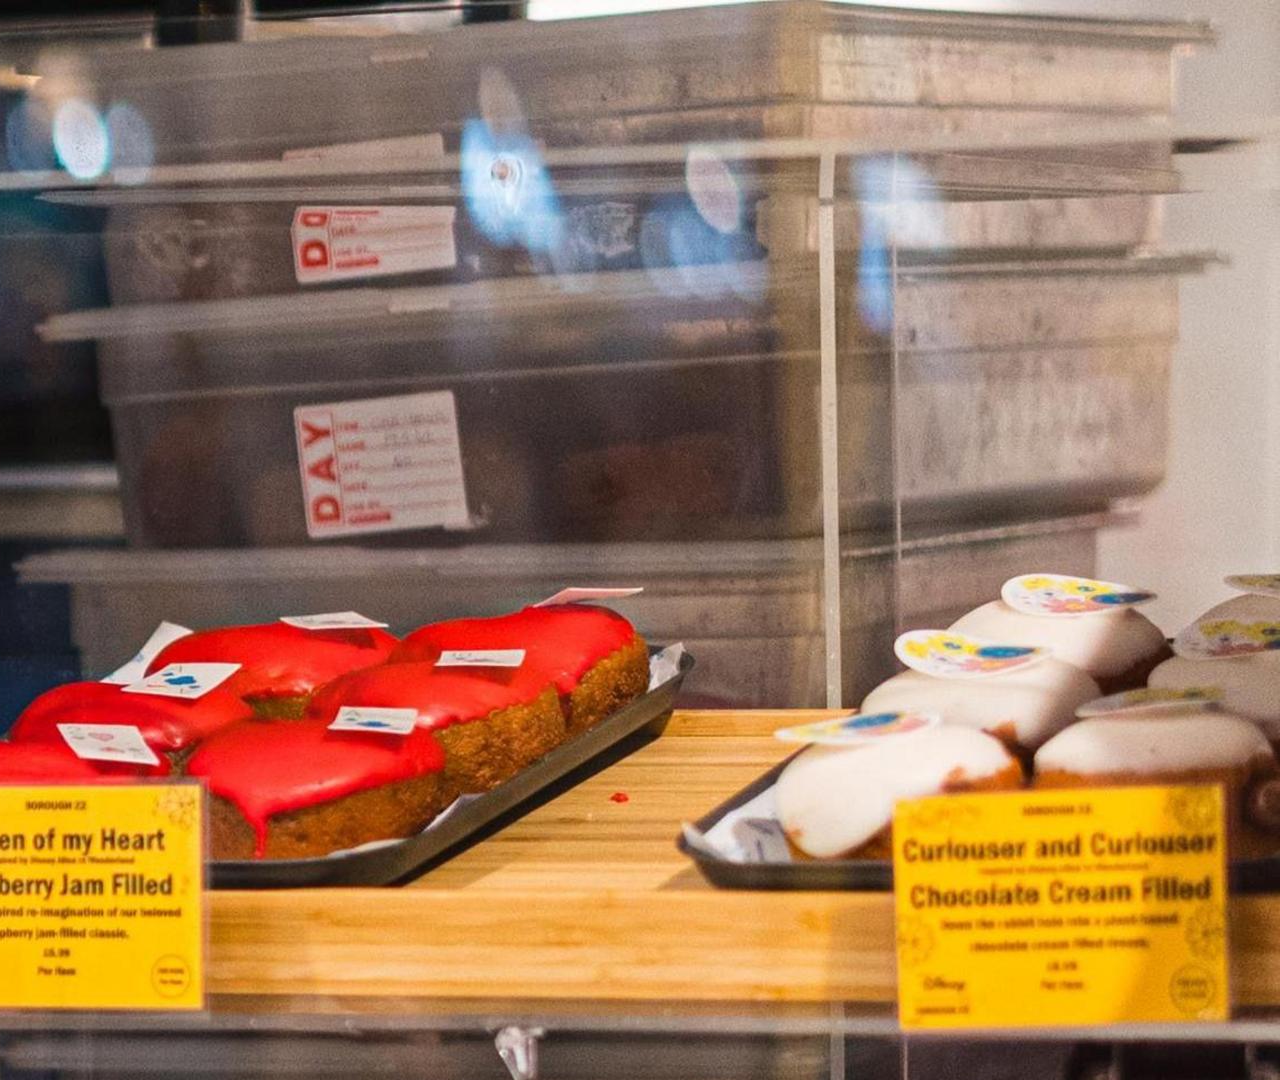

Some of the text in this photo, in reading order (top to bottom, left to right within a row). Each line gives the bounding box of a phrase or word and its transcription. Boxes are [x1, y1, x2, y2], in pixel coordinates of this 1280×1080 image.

[302, 420, 341, 524] DAY
[32, 827, 56, 850] of
[61, 833, 93, 855] my
[100, 828, 165, 851] Heart
[902, 831, 1218, 862] Curiouser and Curiouser
[60, 873, 104, 896] Jam
[111, 873, 174, 896] Filled
[910, 875, 1213, 909] Chocolate Cream Filled
